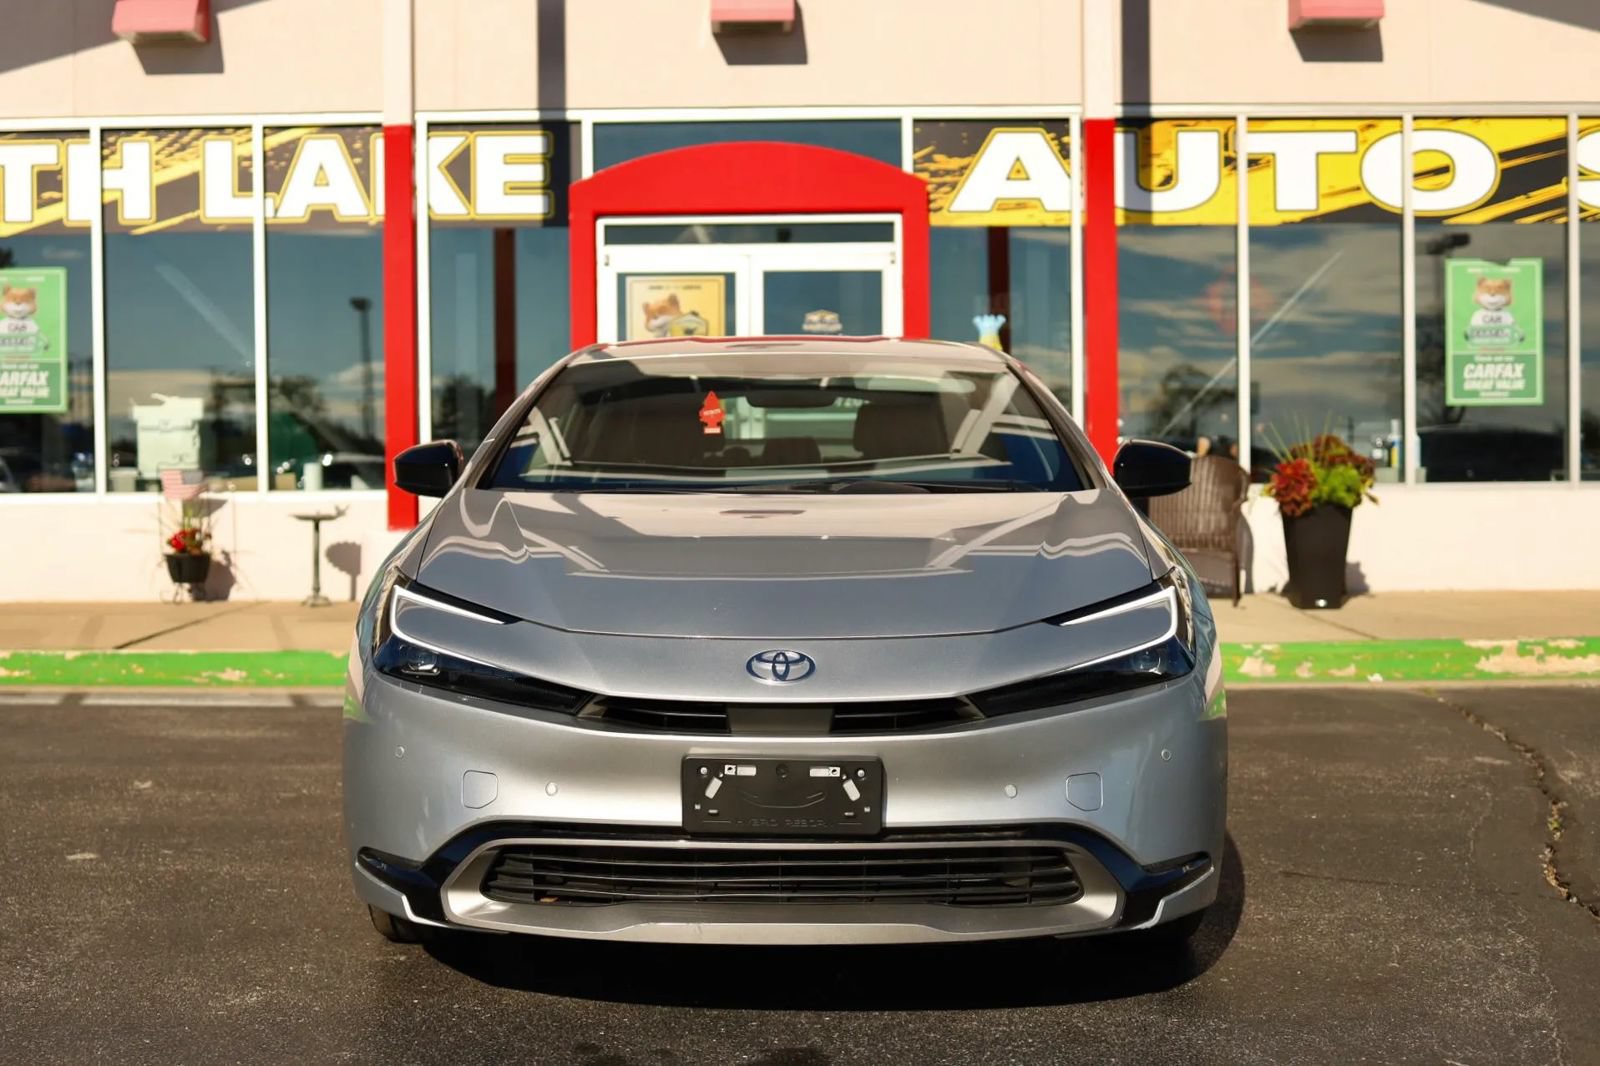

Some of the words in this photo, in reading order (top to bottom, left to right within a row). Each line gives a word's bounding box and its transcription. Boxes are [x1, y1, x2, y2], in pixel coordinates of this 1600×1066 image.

[200, 132, 554, 224] LAKE
[946, 126, 1501, 217] AUTO
[1463, 363, 1526, 379] CARFAX
